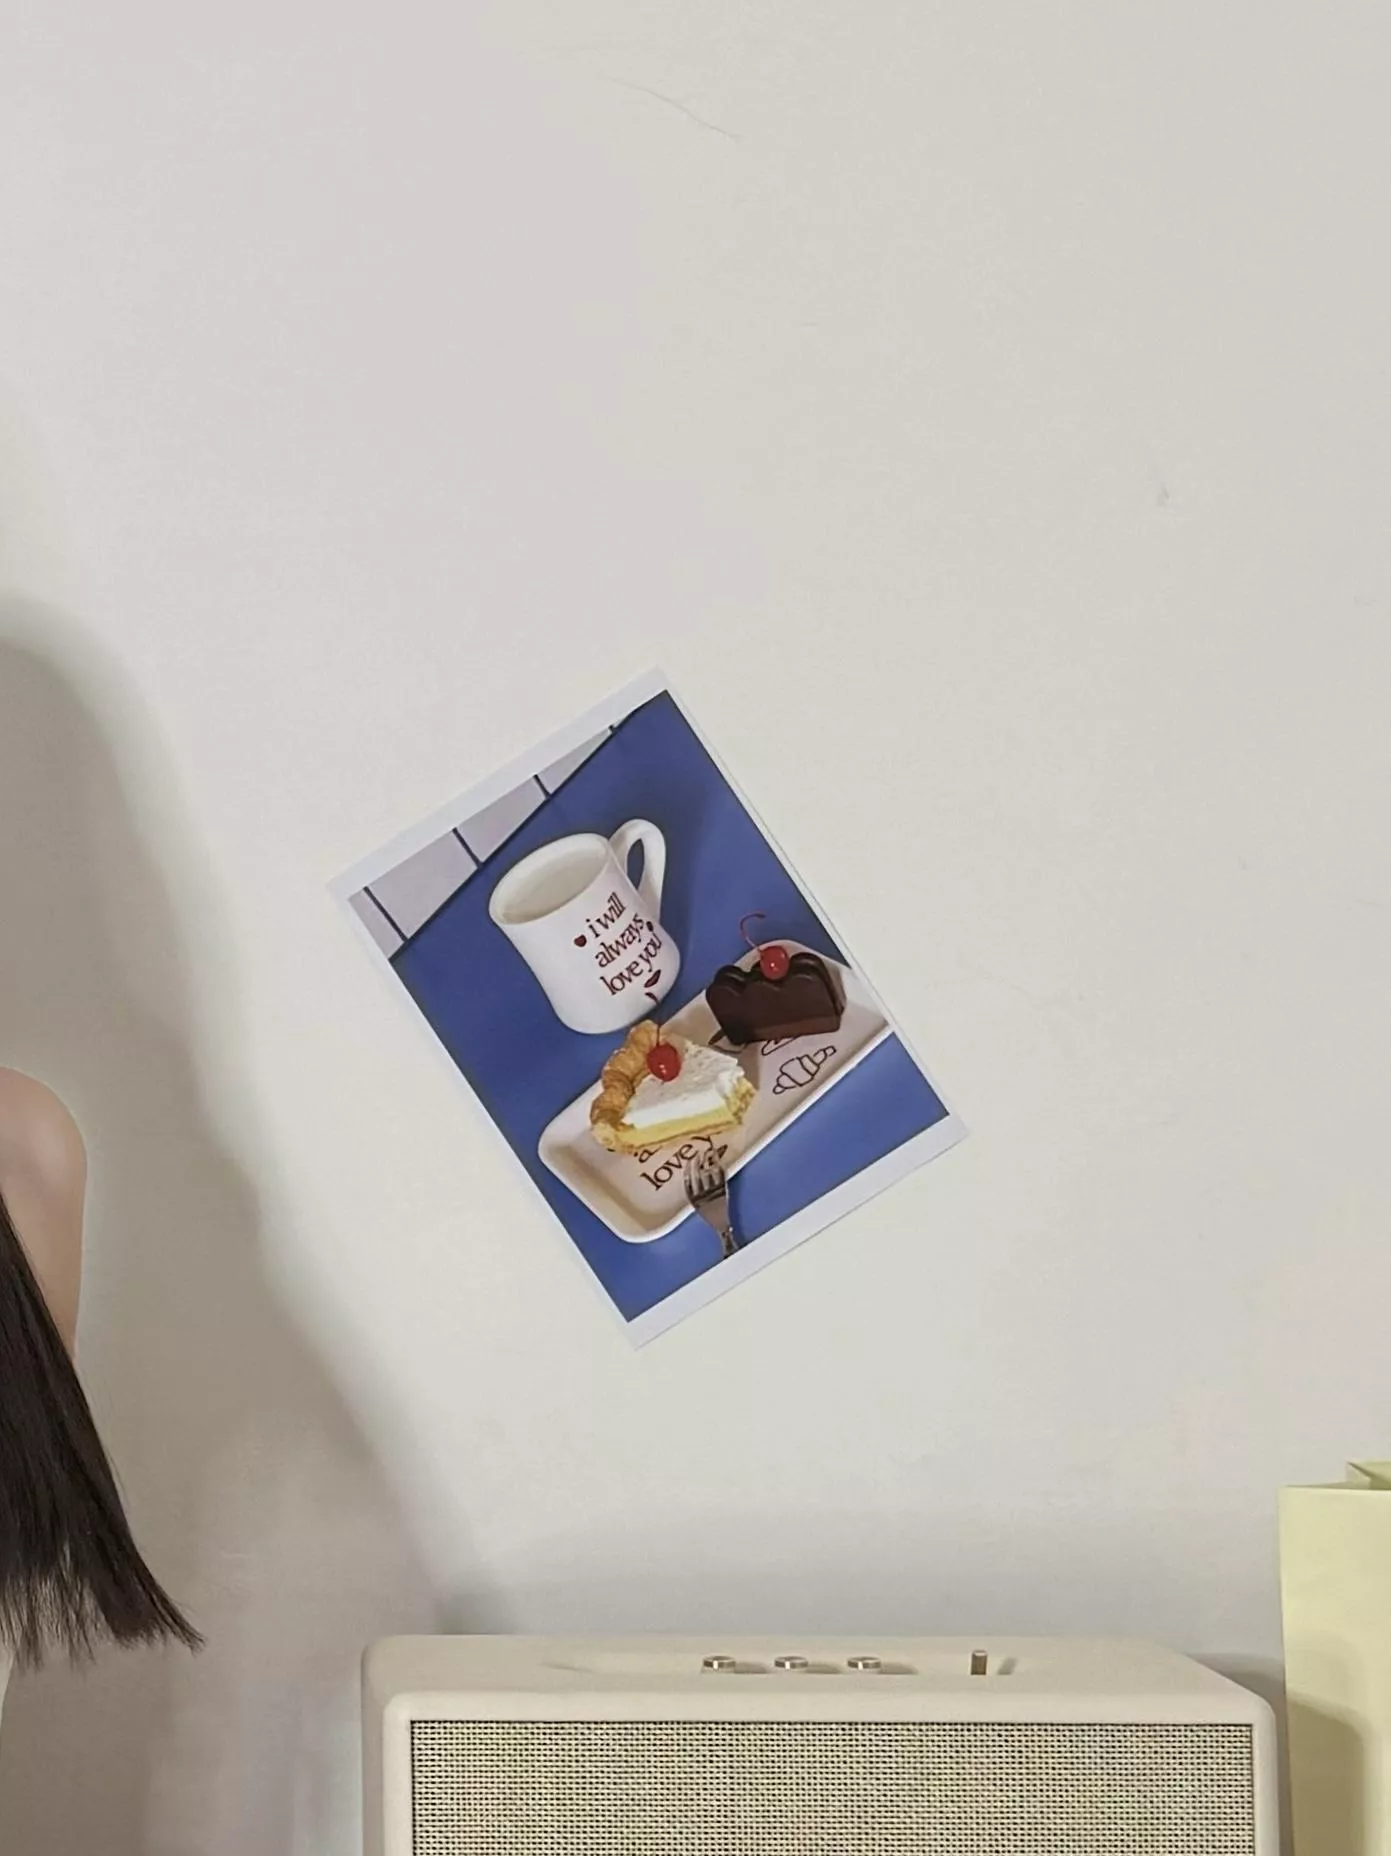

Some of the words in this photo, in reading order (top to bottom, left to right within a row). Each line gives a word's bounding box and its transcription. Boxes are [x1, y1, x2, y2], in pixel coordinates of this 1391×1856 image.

[585, 918, 601, 938] i
[595, 891, 627, 930] will
[594, 912, 644, 968] always
[599, 961, 644, 996] love
[638, 930, 662, 973] you
[639, 1143, 699, 1191] love
